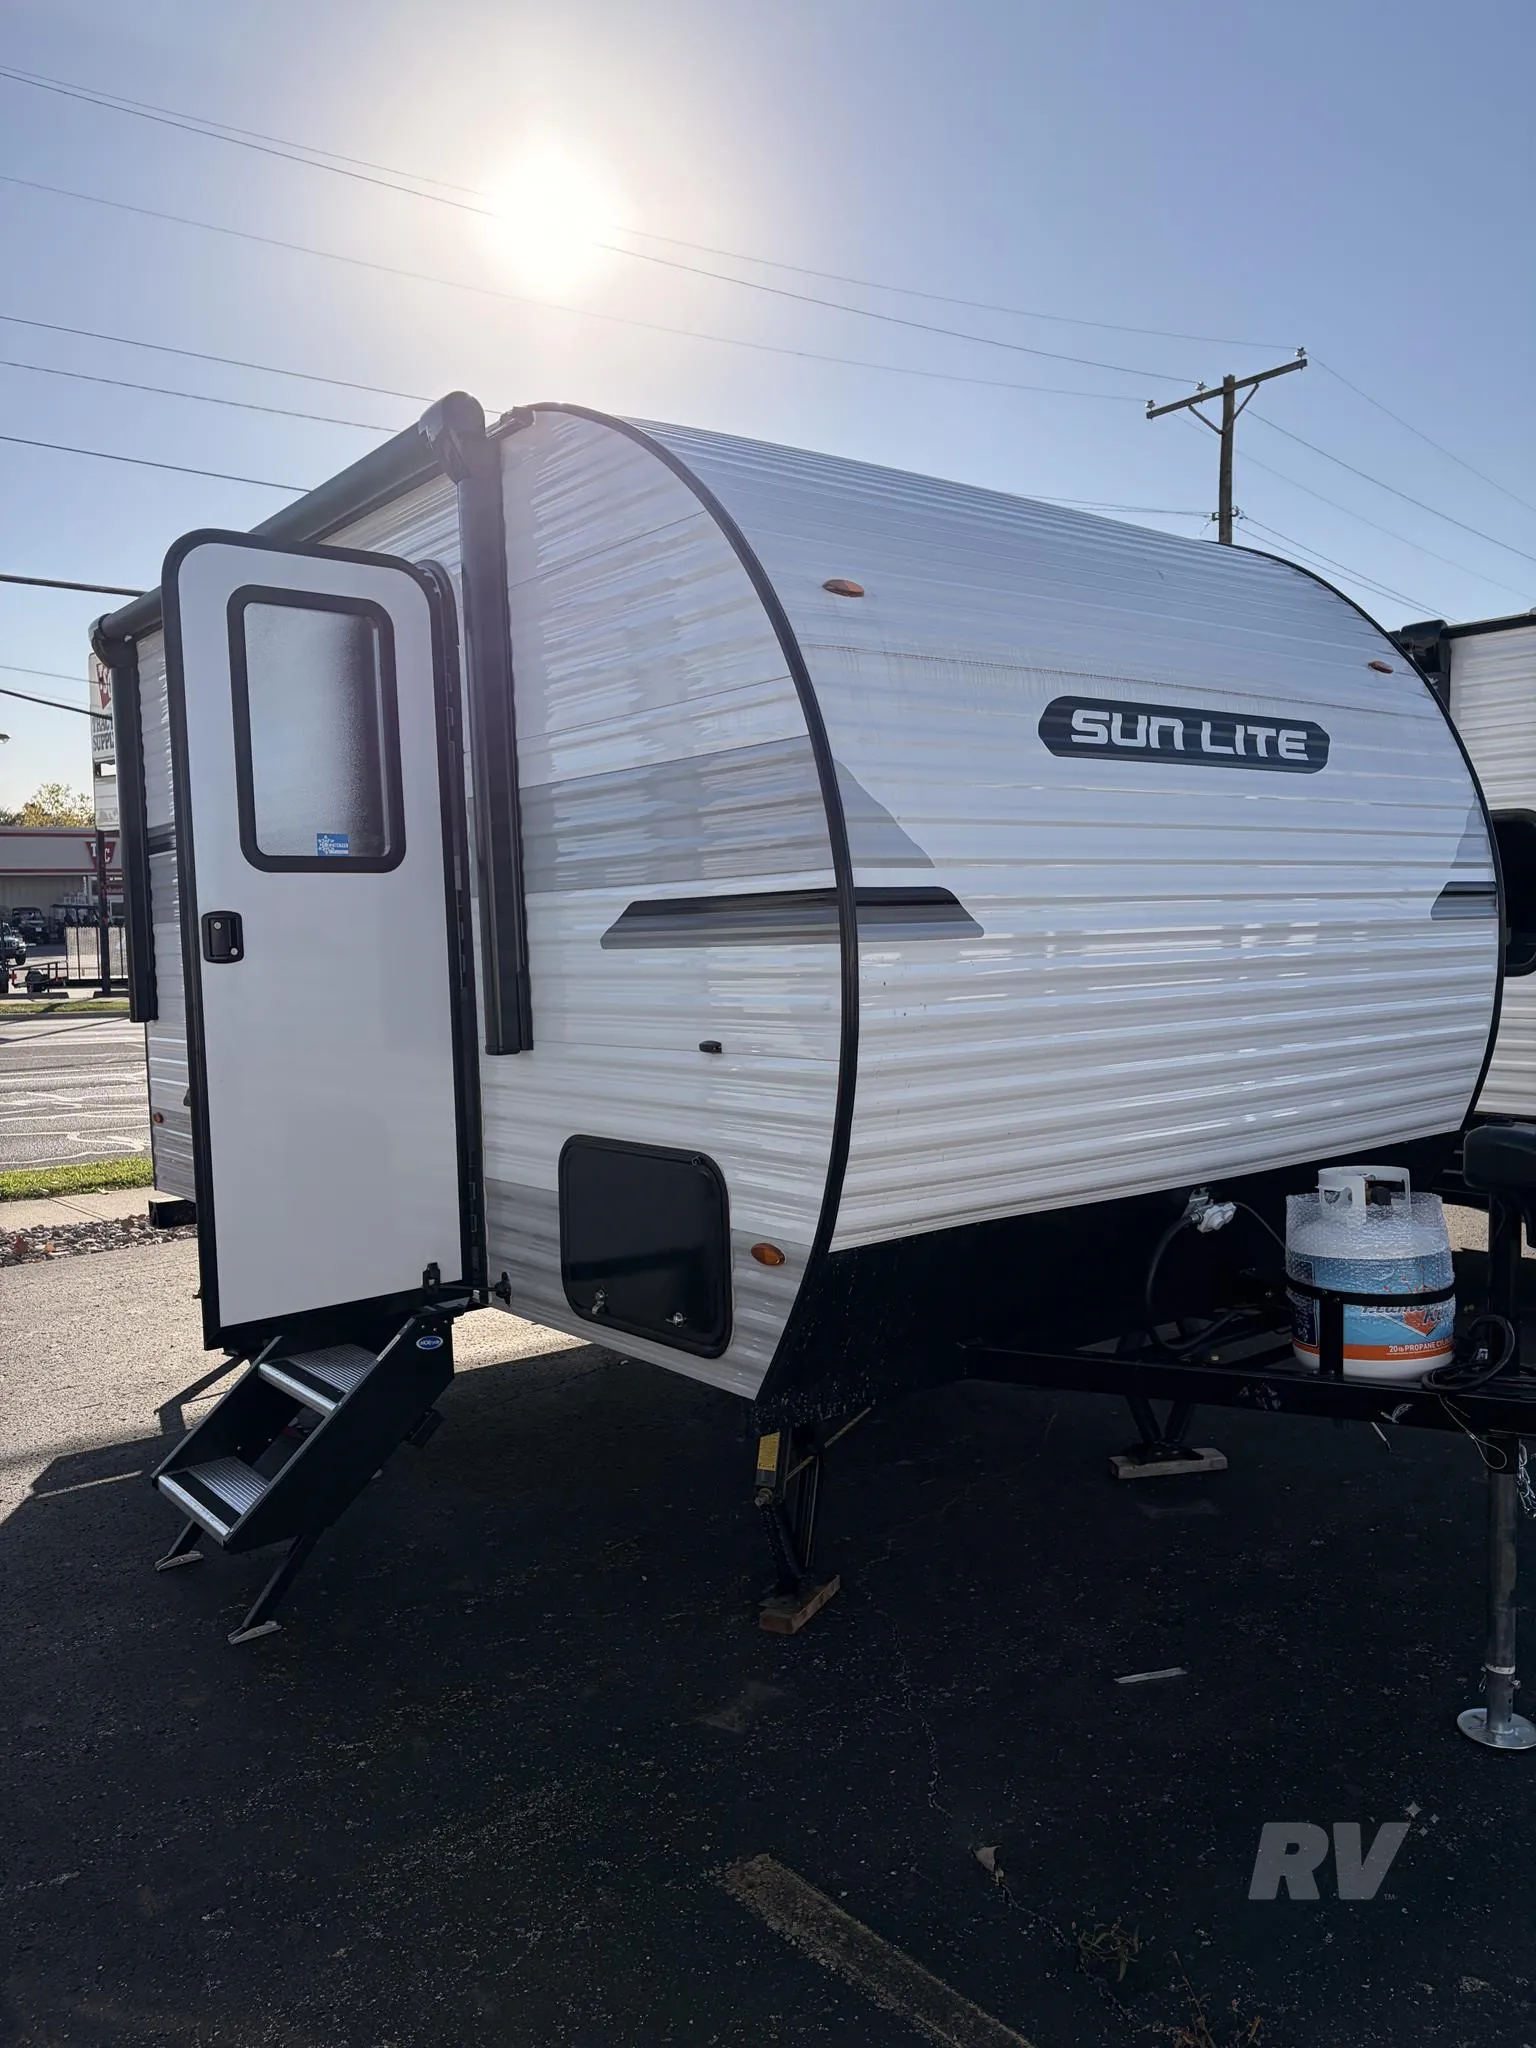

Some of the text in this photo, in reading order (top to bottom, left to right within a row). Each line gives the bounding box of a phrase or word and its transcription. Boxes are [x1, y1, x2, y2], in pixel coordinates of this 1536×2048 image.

[93, 732, 115, 752] SUPPL
[1070, 709, 1309, 761] SUN LITE
[90, 843, 111, 863] TC
[1405, 1342, 1436, 1351] PROPANE
